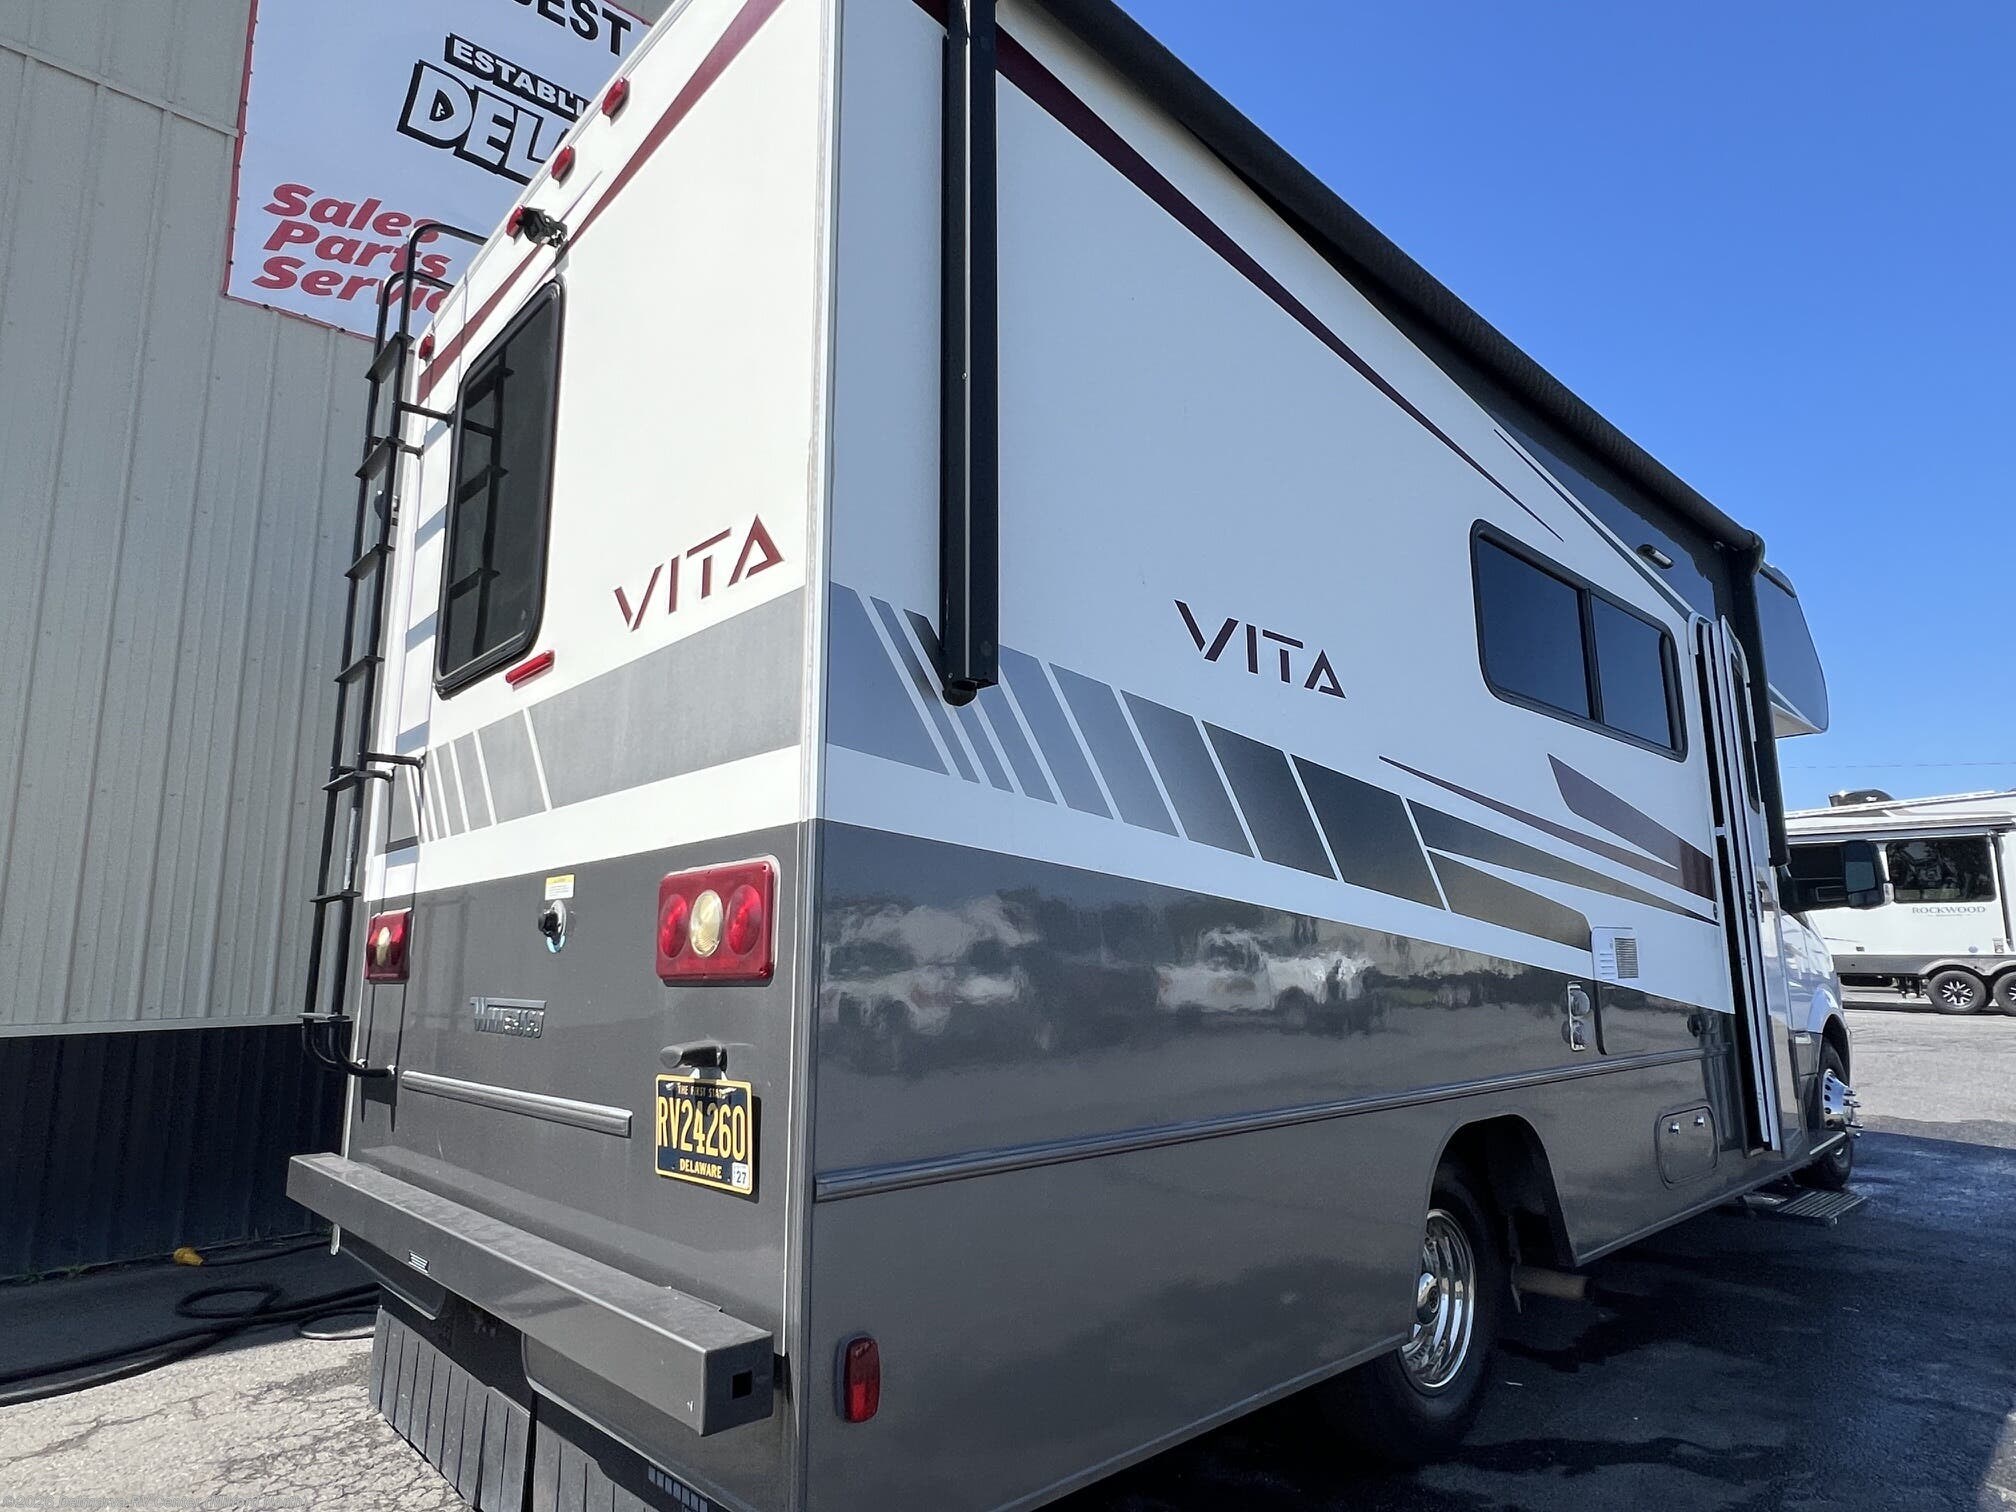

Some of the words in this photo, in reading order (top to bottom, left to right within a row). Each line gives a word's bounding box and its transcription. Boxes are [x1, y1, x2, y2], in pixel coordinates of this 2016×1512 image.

[513, 0, 631, 56] EST
[397, 59, 569, 186] DEL
[263, 184, 439, 243] Sales
[263, 219, 452, 278] Parts
[614, 514, 784, 632] VITA
[1173, 599, 1346, 699] VITA
[1912, 906, 1986, 914] ROCKWOOD
[658, 1096, 746, 1161] RV24260
[680, 1158, 722, 1179] DELAWARE
[736, 1170, 747, 1185] 27
